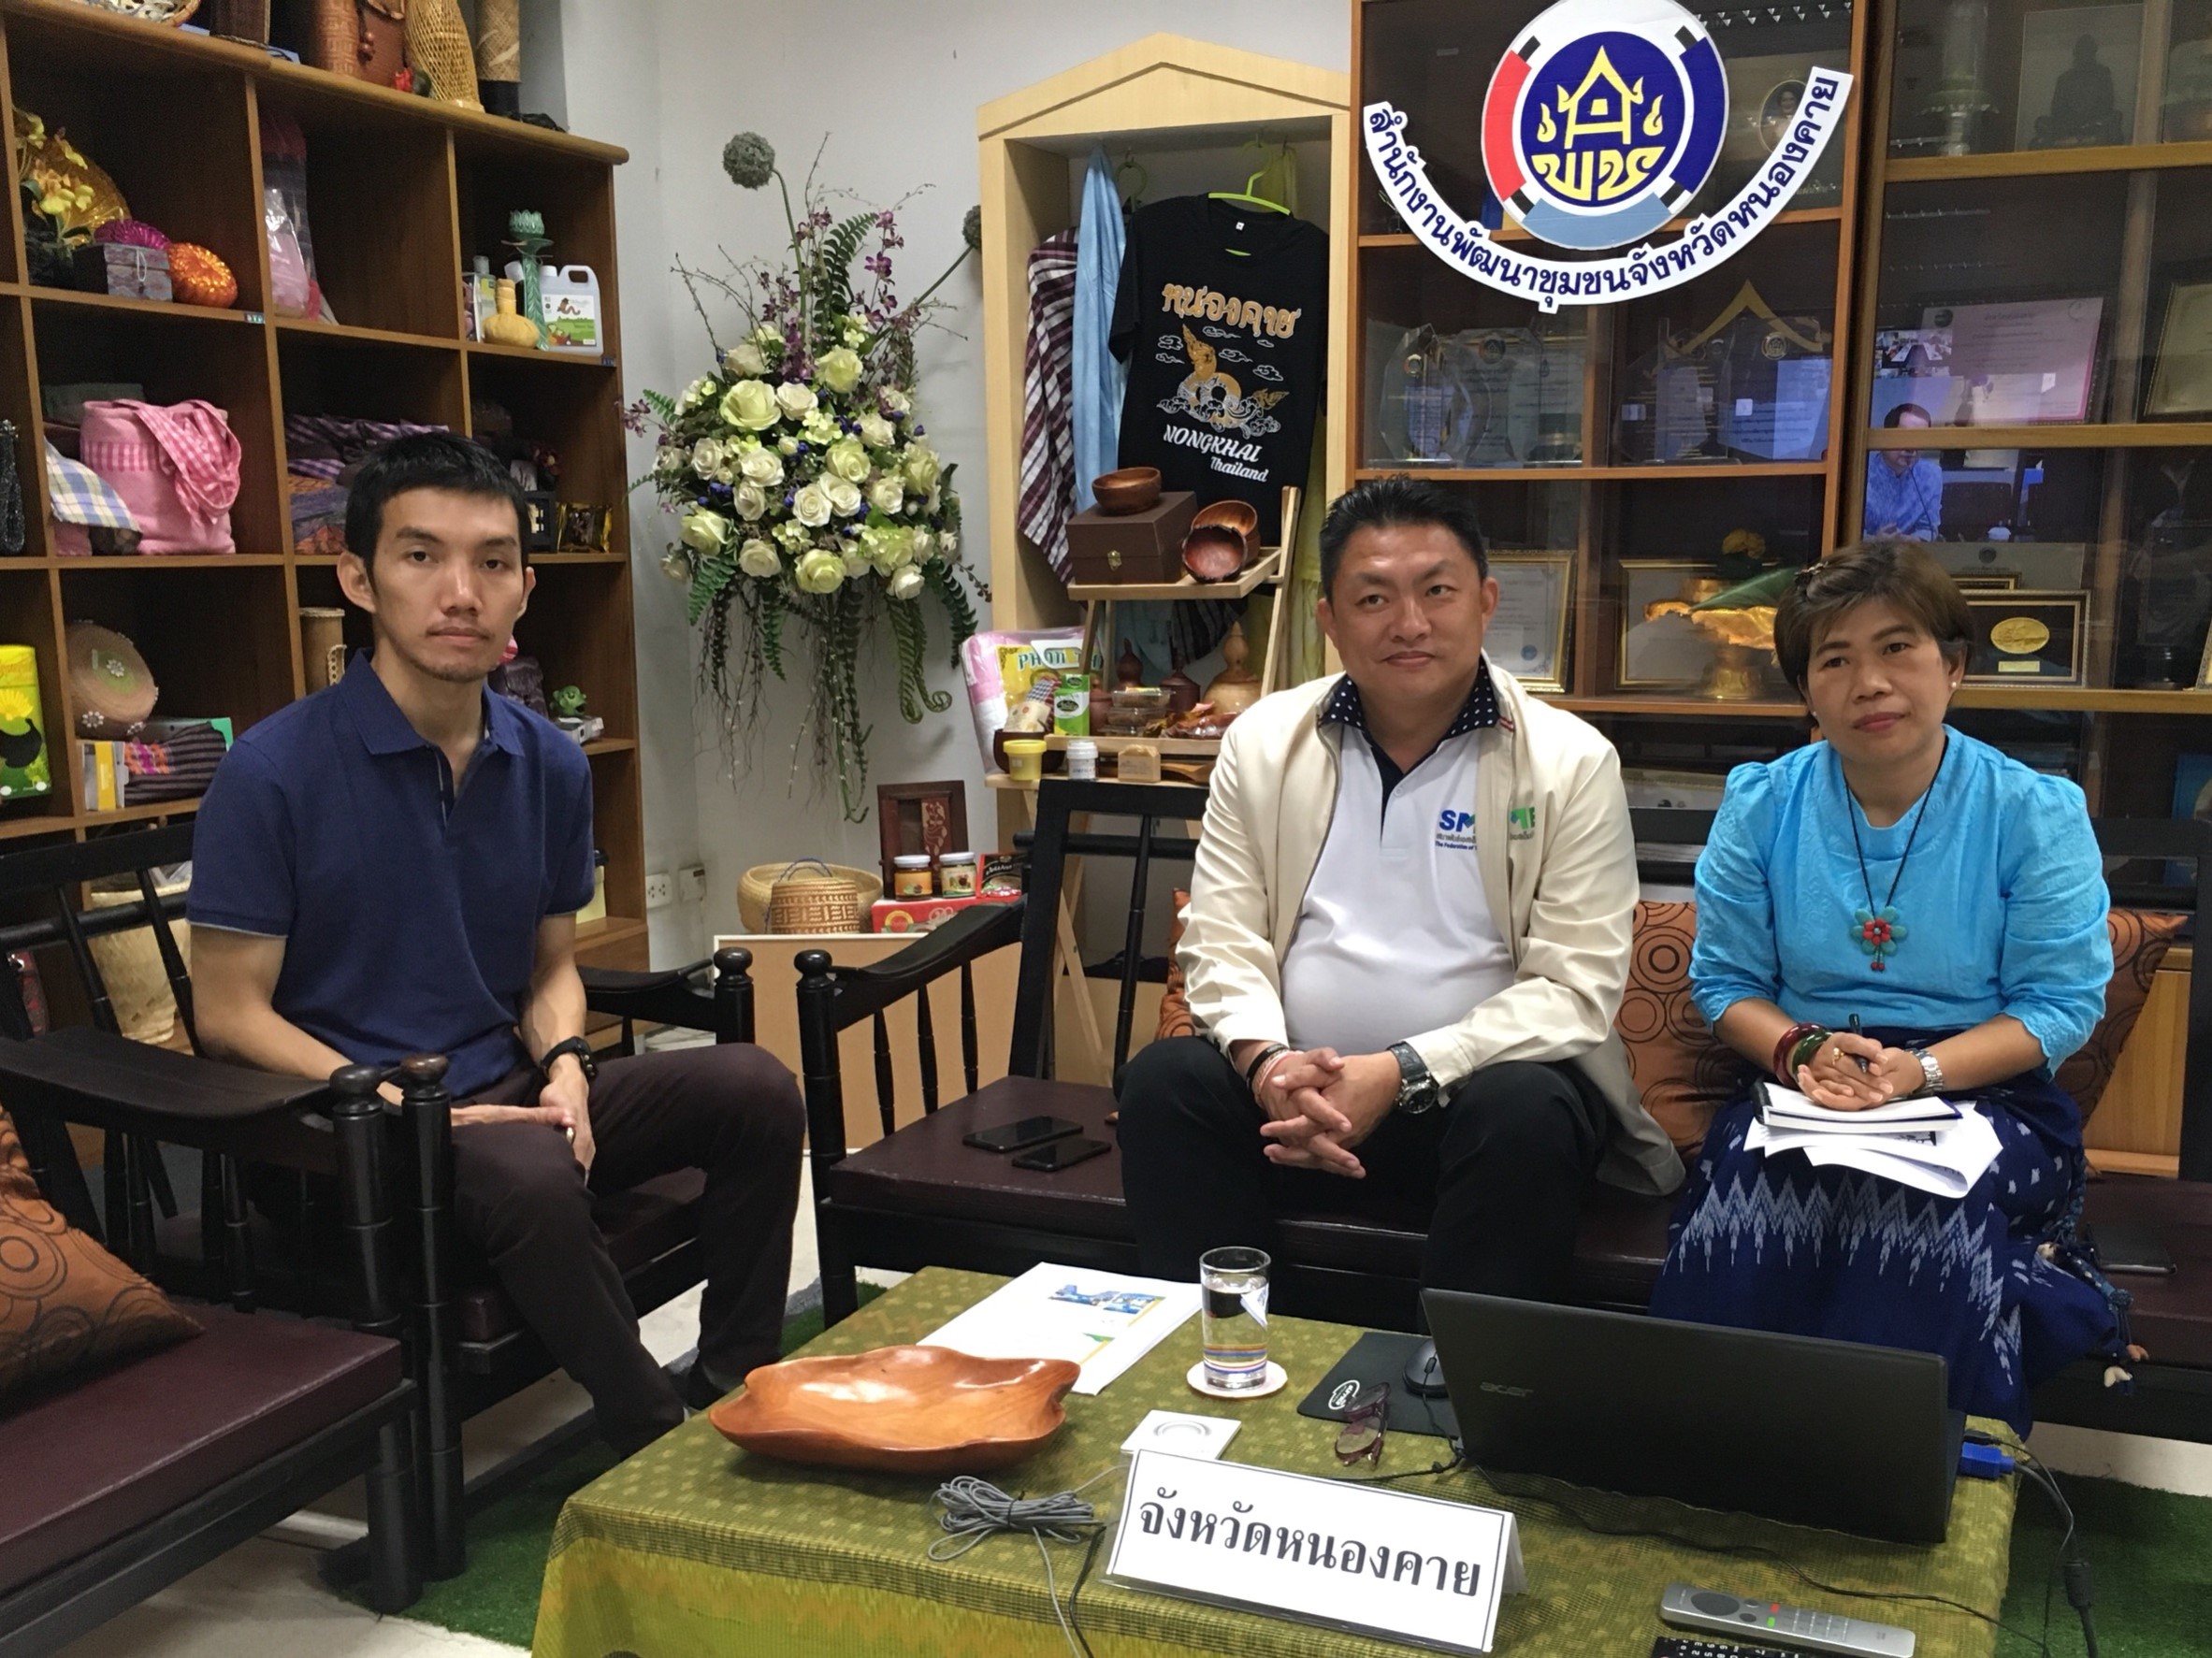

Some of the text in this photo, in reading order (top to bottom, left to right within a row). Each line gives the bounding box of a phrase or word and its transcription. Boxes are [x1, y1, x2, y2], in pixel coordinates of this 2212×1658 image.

[1367, 76, 1840, 309] สำนักงานพัฒนาชุมชนจังหวัดหนองคาย
[1161, 281, 1301, 339] หนองคาย
[1162, 424, 1264, 464] NONGKHAI
[1209, 455, 1269, 483] Thailand
[1479, 1381, 1535, 1398] acer
[1138, 1486, 1482, 1598] จังหวัดหนองคาย
